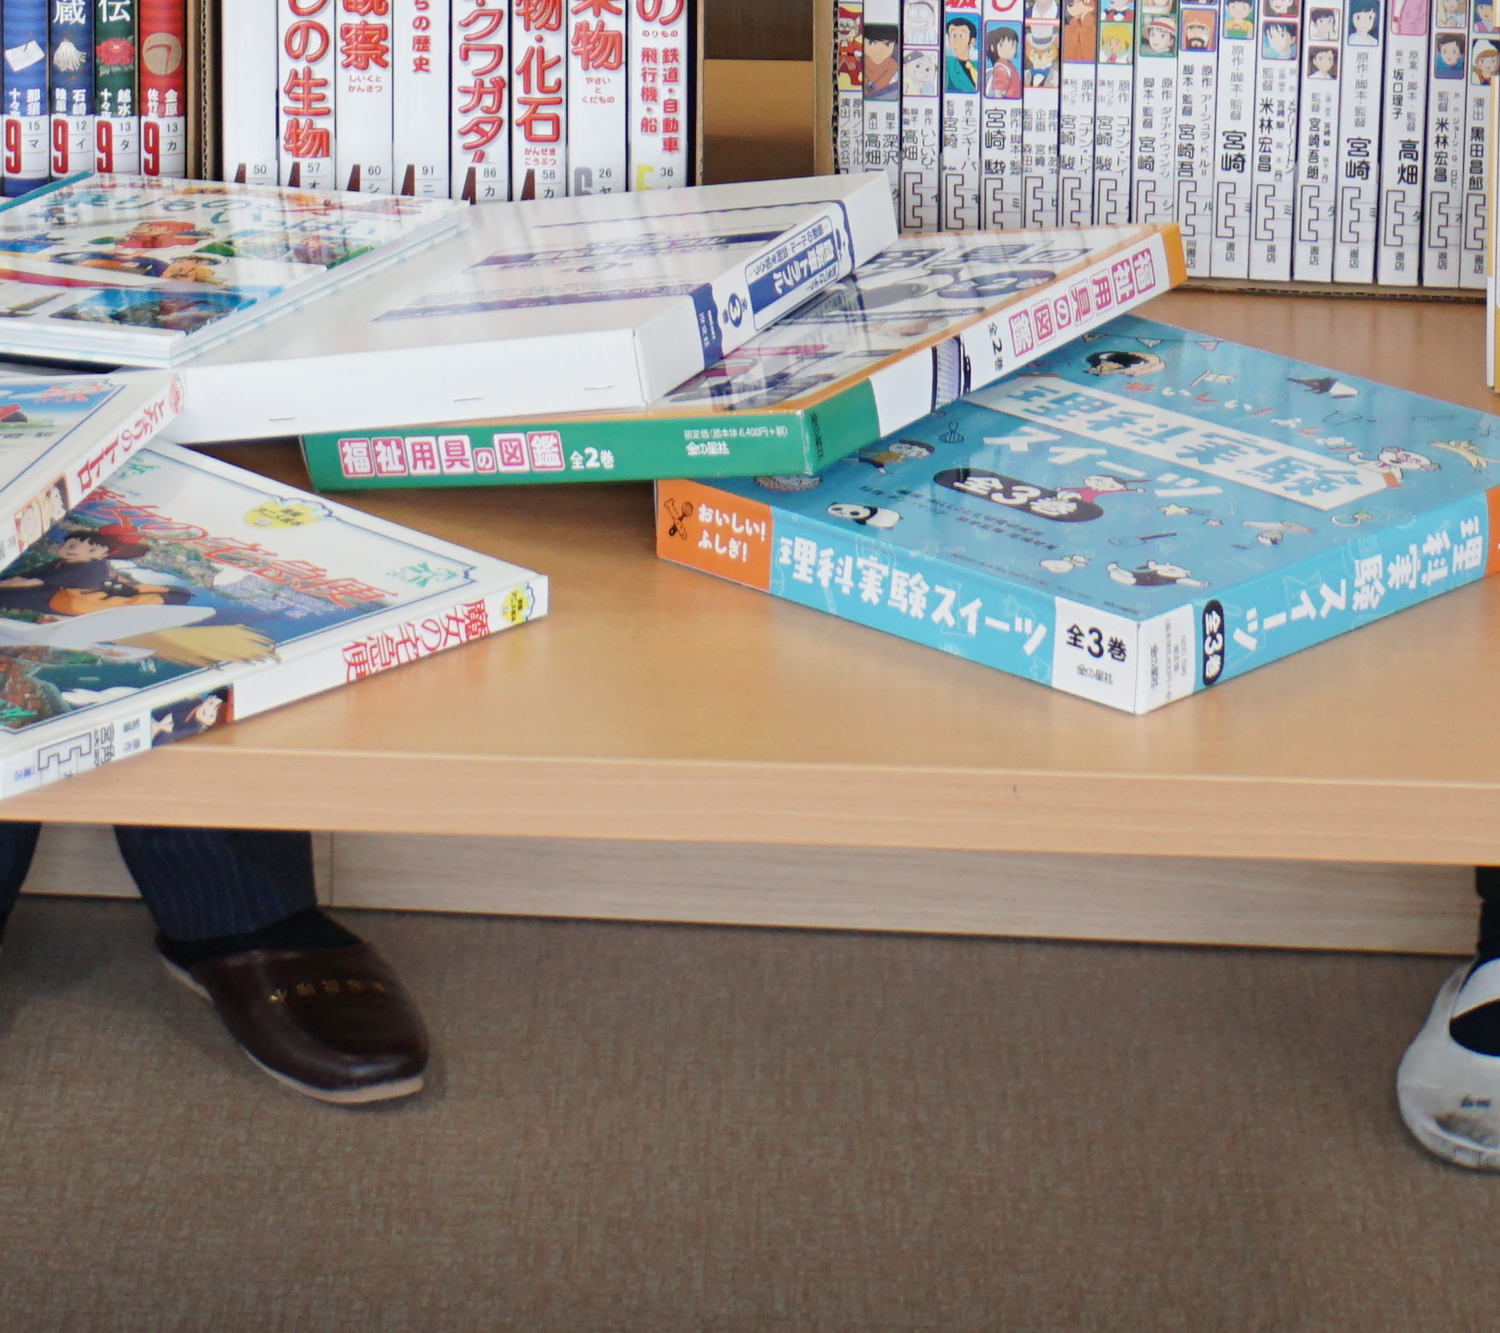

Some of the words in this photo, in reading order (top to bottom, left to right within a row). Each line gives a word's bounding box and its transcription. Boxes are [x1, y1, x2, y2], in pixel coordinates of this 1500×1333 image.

[640, 46, 660, 135] 飛行機・船
[661, 46, 681, 155] 鉄道・自動車
[1009, 248, 1156, 357] 福祉用具の図鑑
[76, 397, 166, 494] となりのトトロ
[338, 430, 566, 478] 福祉用具の図鑑
[569, 447, 615, 471] 全2巻
[697, 502, 767, 542] おいしい!
[697, 535, 749, 563] ふしぎ!
[778, 536, 1047, 656] 理科実験スイーツ
[1232, 514, 1484, 652] 理科実験スイーツ
[341, 597, 492, 683] 魔女の宅急便
[1065, 623, 1128, 663] 全3巻
